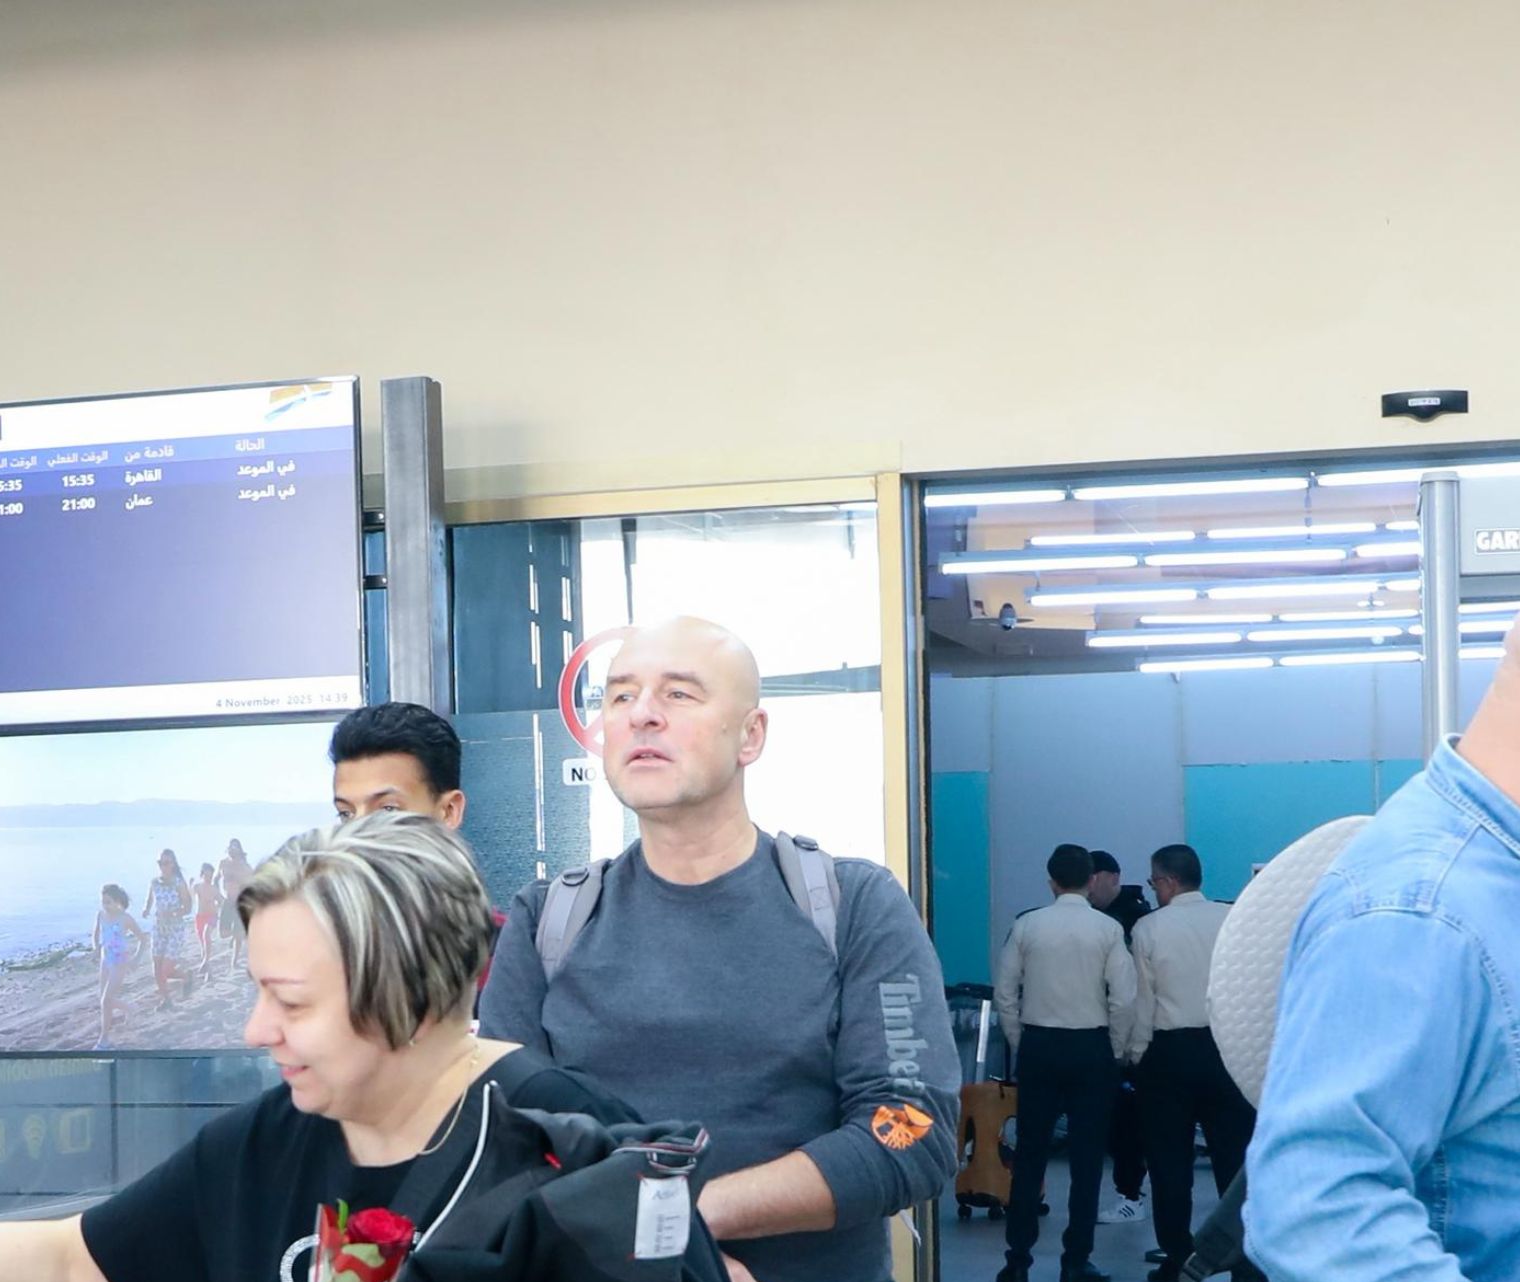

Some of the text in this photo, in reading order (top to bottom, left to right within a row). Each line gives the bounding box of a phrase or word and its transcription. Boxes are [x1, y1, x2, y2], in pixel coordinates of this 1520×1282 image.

[62, 474, 95, 487] 15:35
[61, 497, 96, 511] 21:00
[225, 698, 280, 708] November
[571, 767, 596, 781] NO
